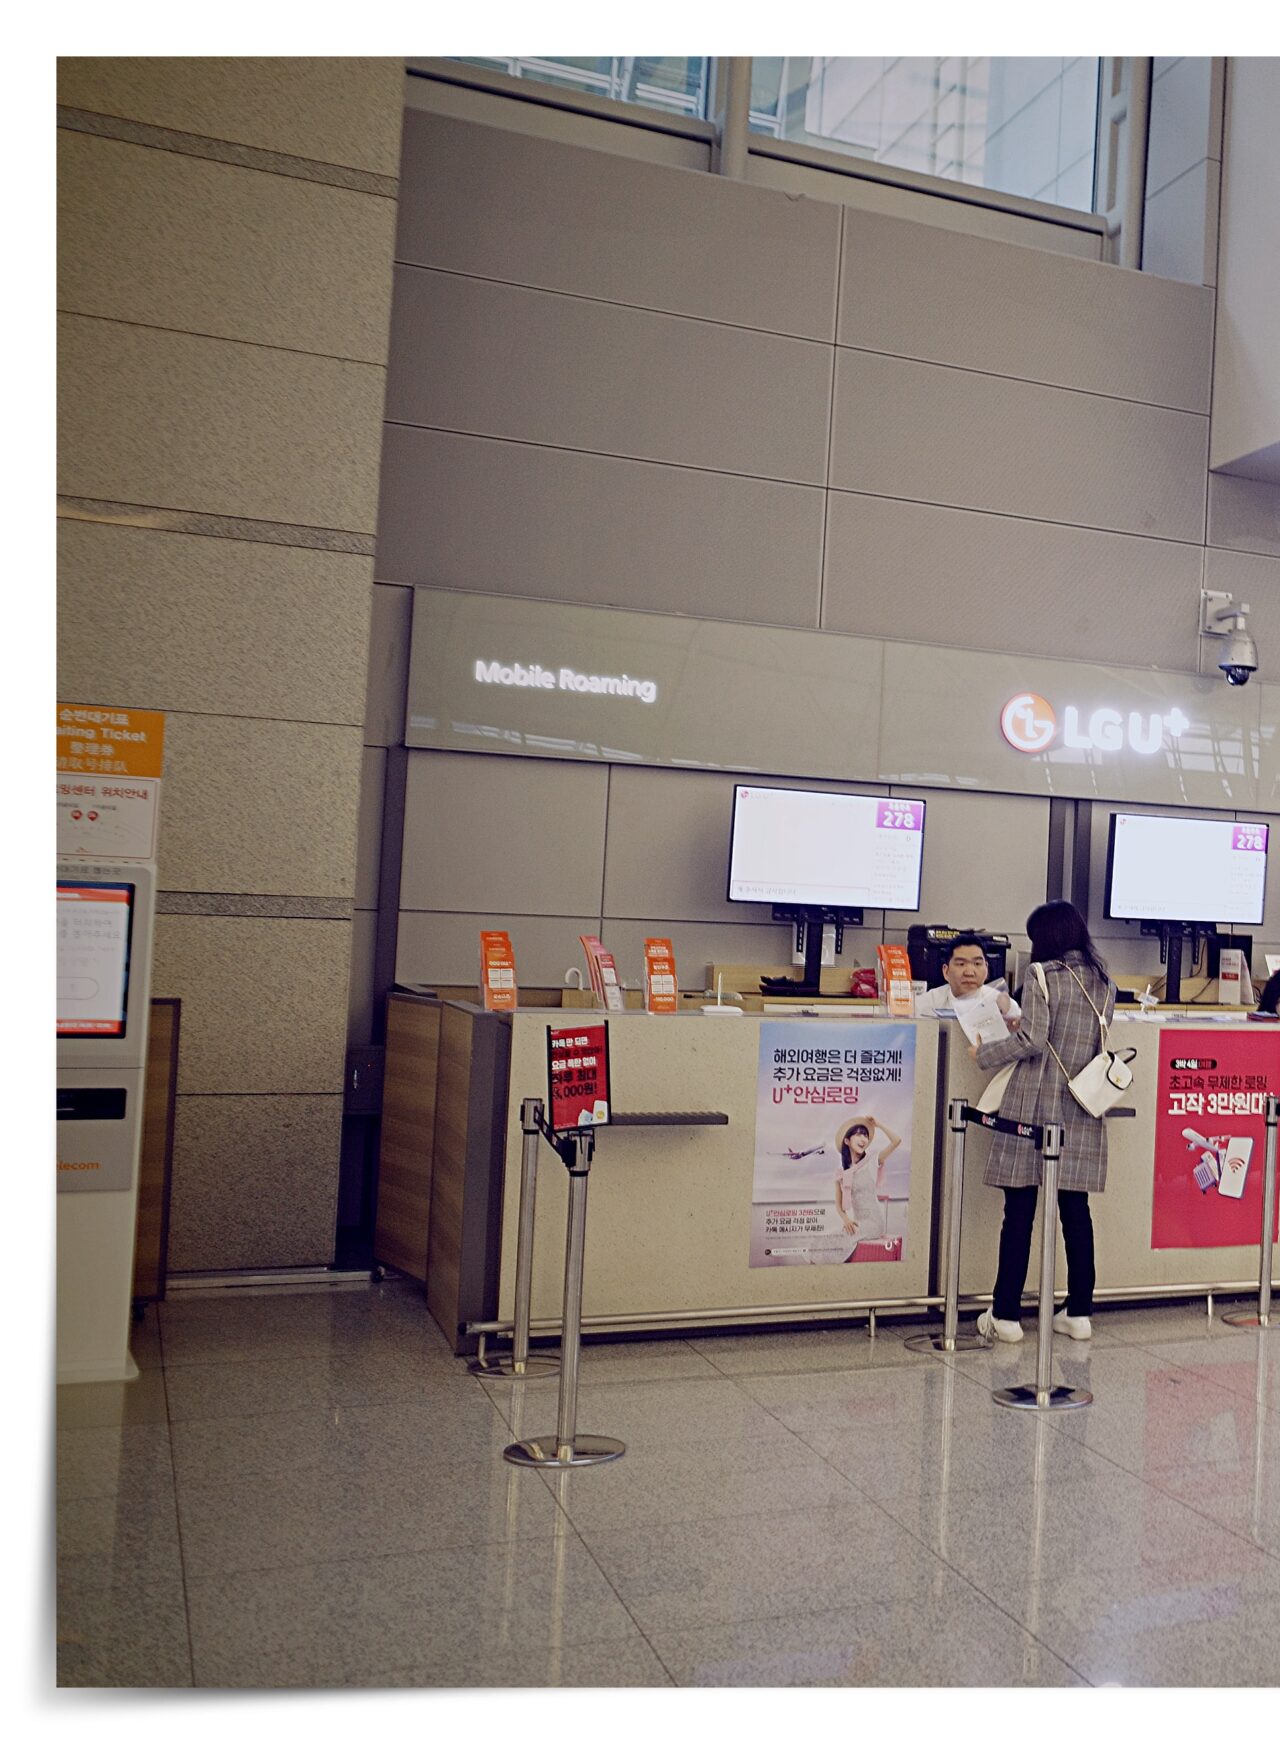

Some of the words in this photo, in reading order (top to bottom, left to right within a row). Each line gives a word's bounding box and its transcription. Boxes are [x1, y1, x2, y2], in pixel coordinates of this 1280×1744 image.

[475, 660, 556, 689] Mobile
[559, 668, 657, 704] Roaming
[100, 728, 148, 743] Ticket
[56, 784, 96, 797] 밍센터
[882, 811, 915, 829] 278
[1236, 833, 1264, 850] 278
[582, 1056, 597, 1067] 없이
[773, 1048, 841, 1064] 해외여행은
[844, 1050, 857, 1064] 더
[860, 1049, 903, 1064] 즐겁게!
[773, 1066, 801, 1082] 추가
[803, 1068, 844, 1082] 요금은
[847, 1068, 902, 1082] 걱정없게!
[1168, 1075, 1205, 1090] 초고속
[1207, 1075, 1243, 1090] 무제한
[1244, 1075, 1268, 1090] 로밍
[1167, 1092, 1206, 1116] 고작
[765, 1217, 779, 1226] 추가
